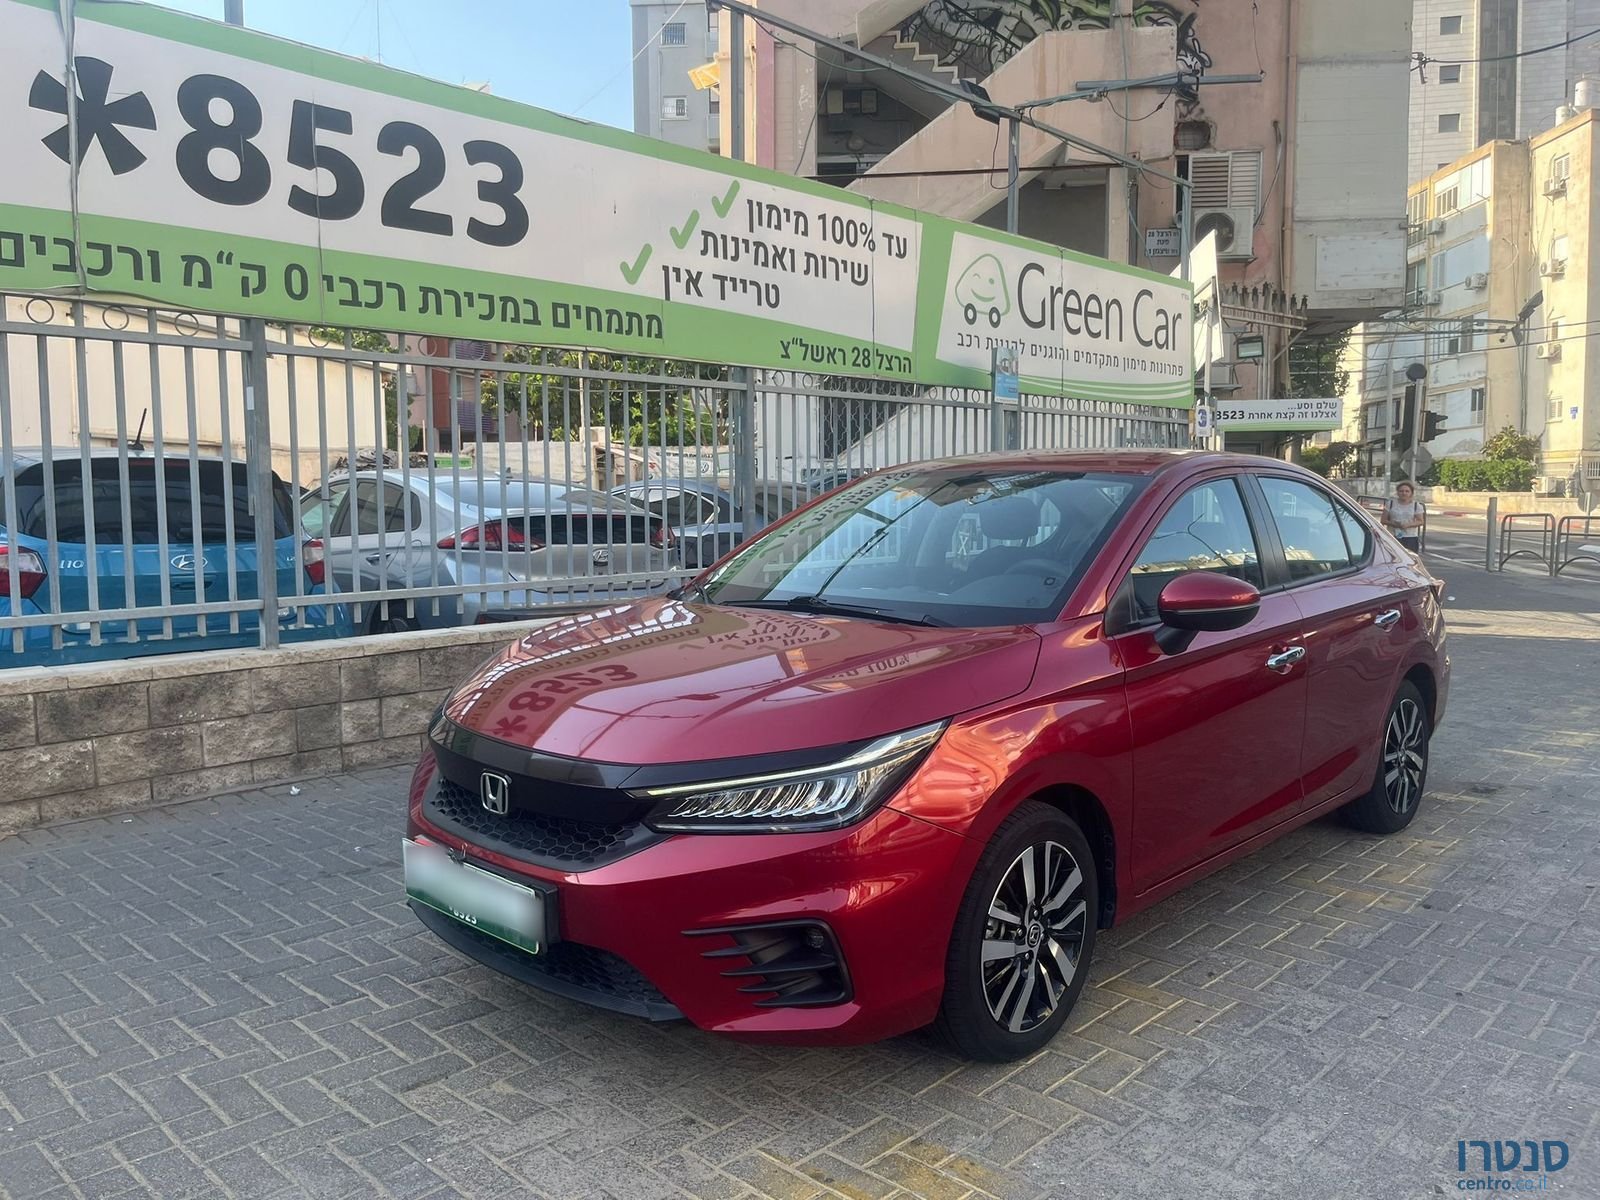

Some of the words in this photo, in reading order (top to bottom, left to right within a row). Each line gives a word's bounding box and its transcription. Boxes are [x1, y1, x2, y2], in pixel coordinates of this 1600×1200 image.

[746, 199, 809, 237] מימון
[817, 213, 876, 252] 100%
[0, 231, 161, 283] ורכבים
[700, 230, 795, 273] ואמינות
[882, 232, 907, 259] עד
[284, 263, 309, 301] 0
[661, 265, 703, 301] אין
[803, 251, 869, 286] שירות
[322, 275, 406, 312] רכבי
[418, 286, 541, 326] במכירת
[712, 274, 780, 309] טרייד
[1017, 262, 1123, 342] Green
[1132, 287, 1182, 352] Car
[551, 302, 663, 339] מתמחים
[957, 332, 980, 349] רכב
[1030, 343, 1069, 361] והוגנים
[852, 346, 871, 368] 28
[875, 348, 912, 373] הרצל
[1073, 349, 1119, 368] מתקדמים
[1122, 356, 1147, 372] מימון
[1149, 360, 1184, 376] פתרונות
[1247, 411, 1273, 420] אחרת
[1275, 410, 1295, 420] קצת
[1310, 410, 1337, 419] אצלנו
[1316, 401, 1337, 410] שלם
